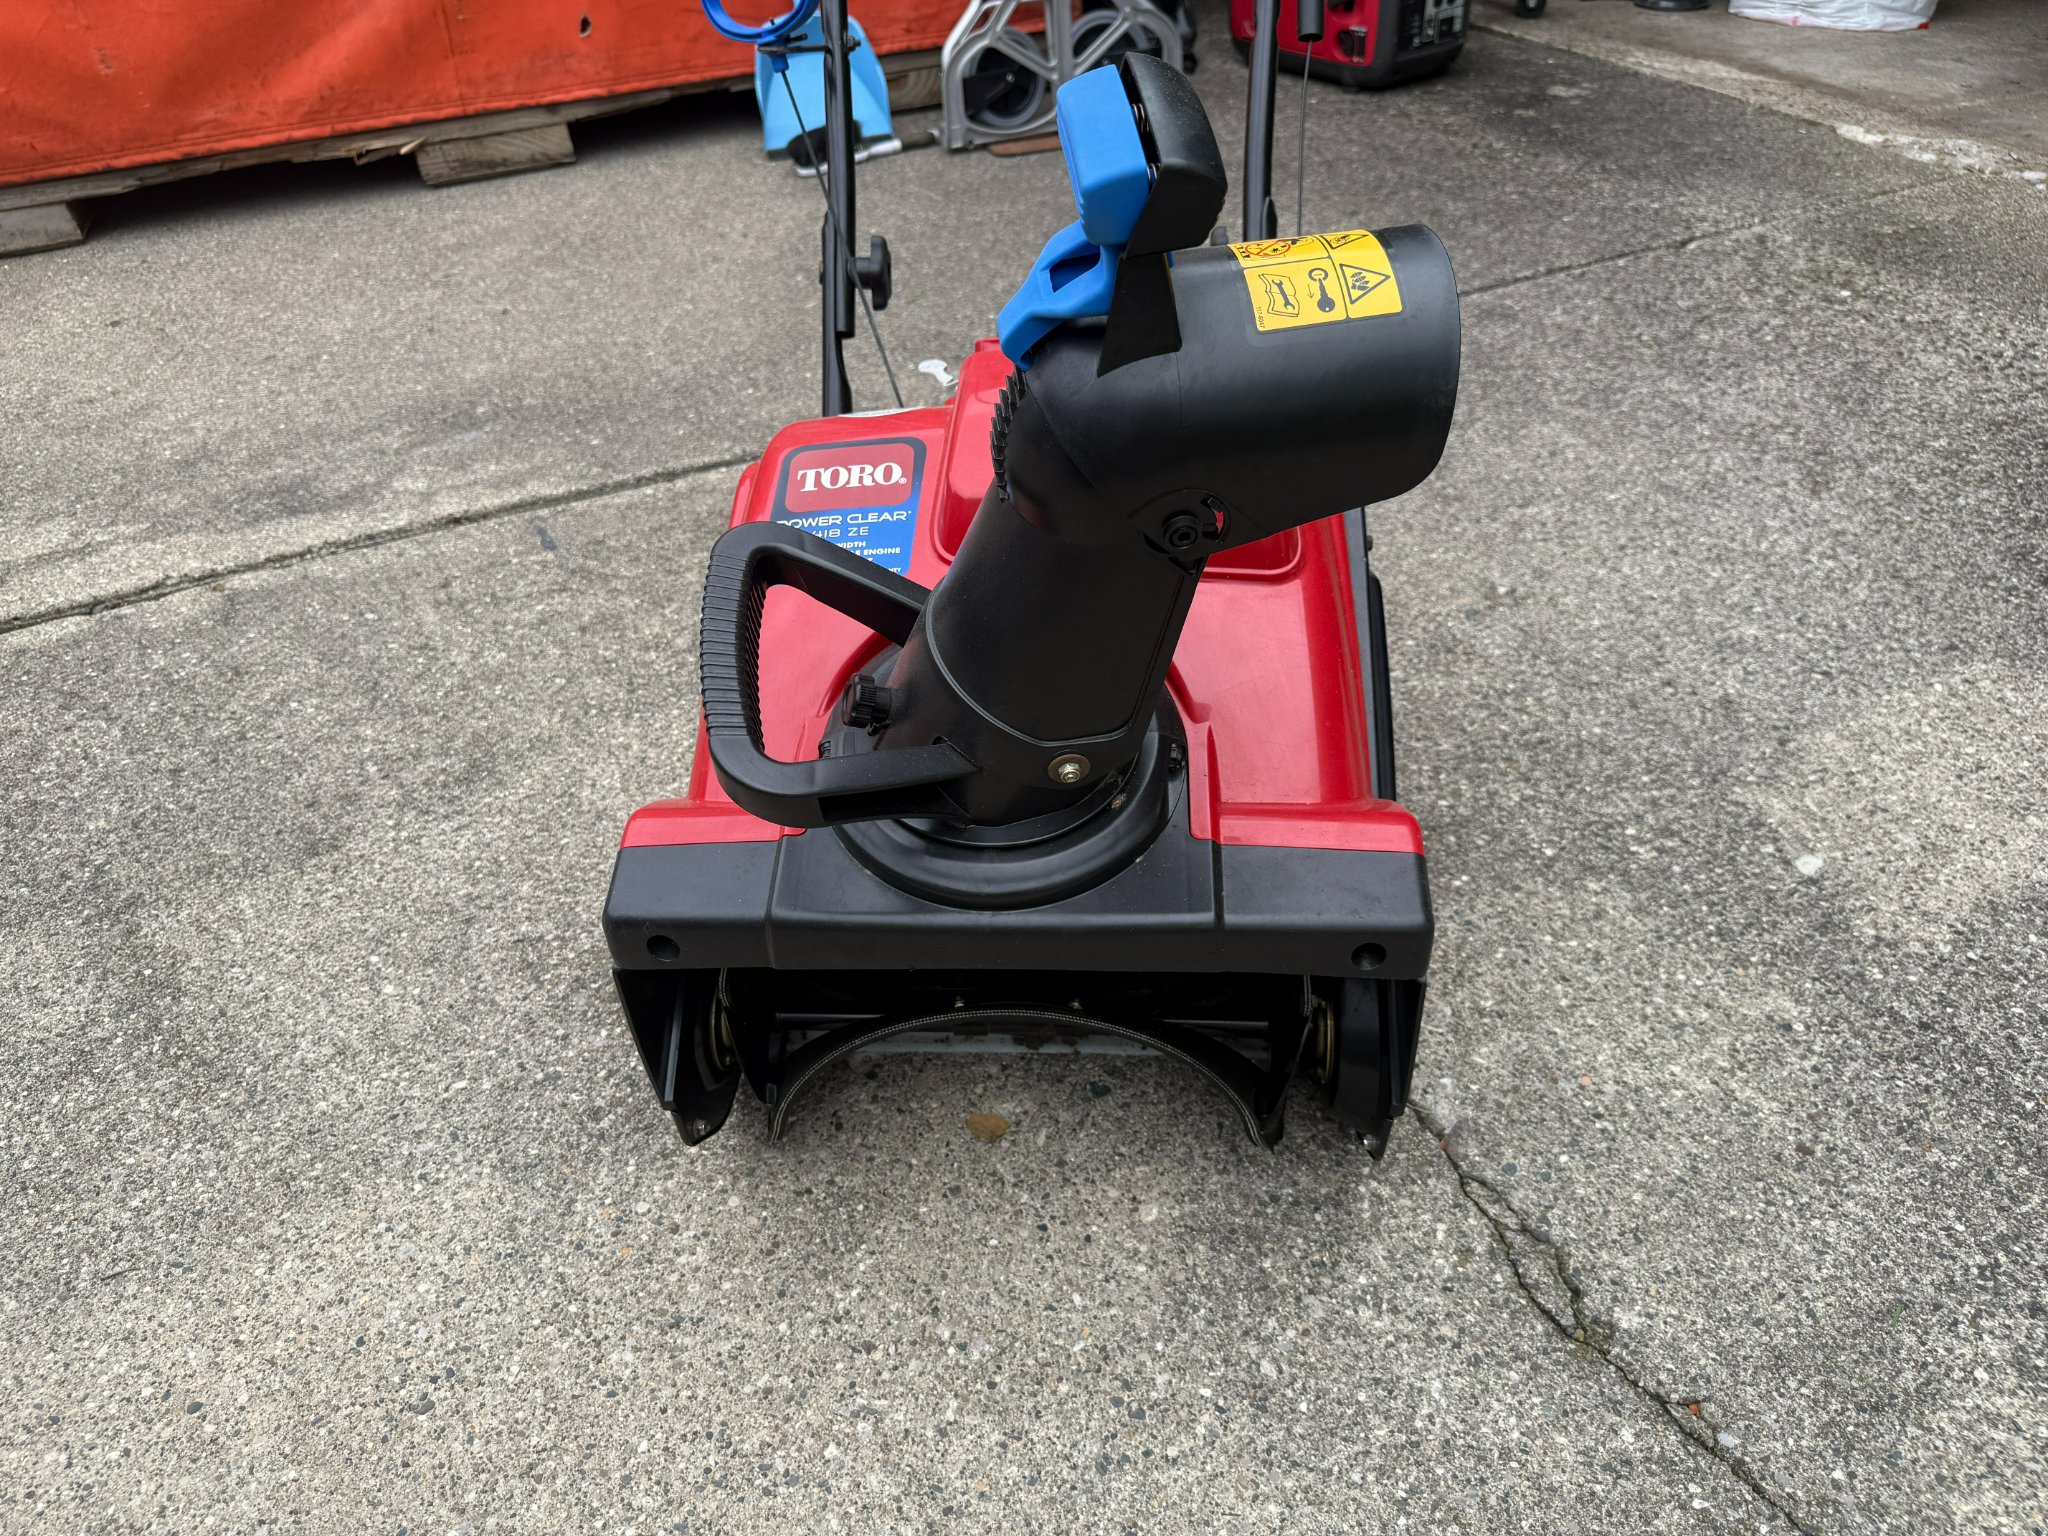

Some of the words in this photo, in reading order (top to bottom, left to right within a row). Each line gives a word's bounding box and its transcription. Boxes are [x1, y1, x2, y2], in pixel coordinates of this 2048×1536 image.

[797, 462, 903, 492] TORO
[847, 511, 907, 524] CLEAR
[847, 526, 870, 537] ZE
[863, 547, 901, 556] ENGINE
